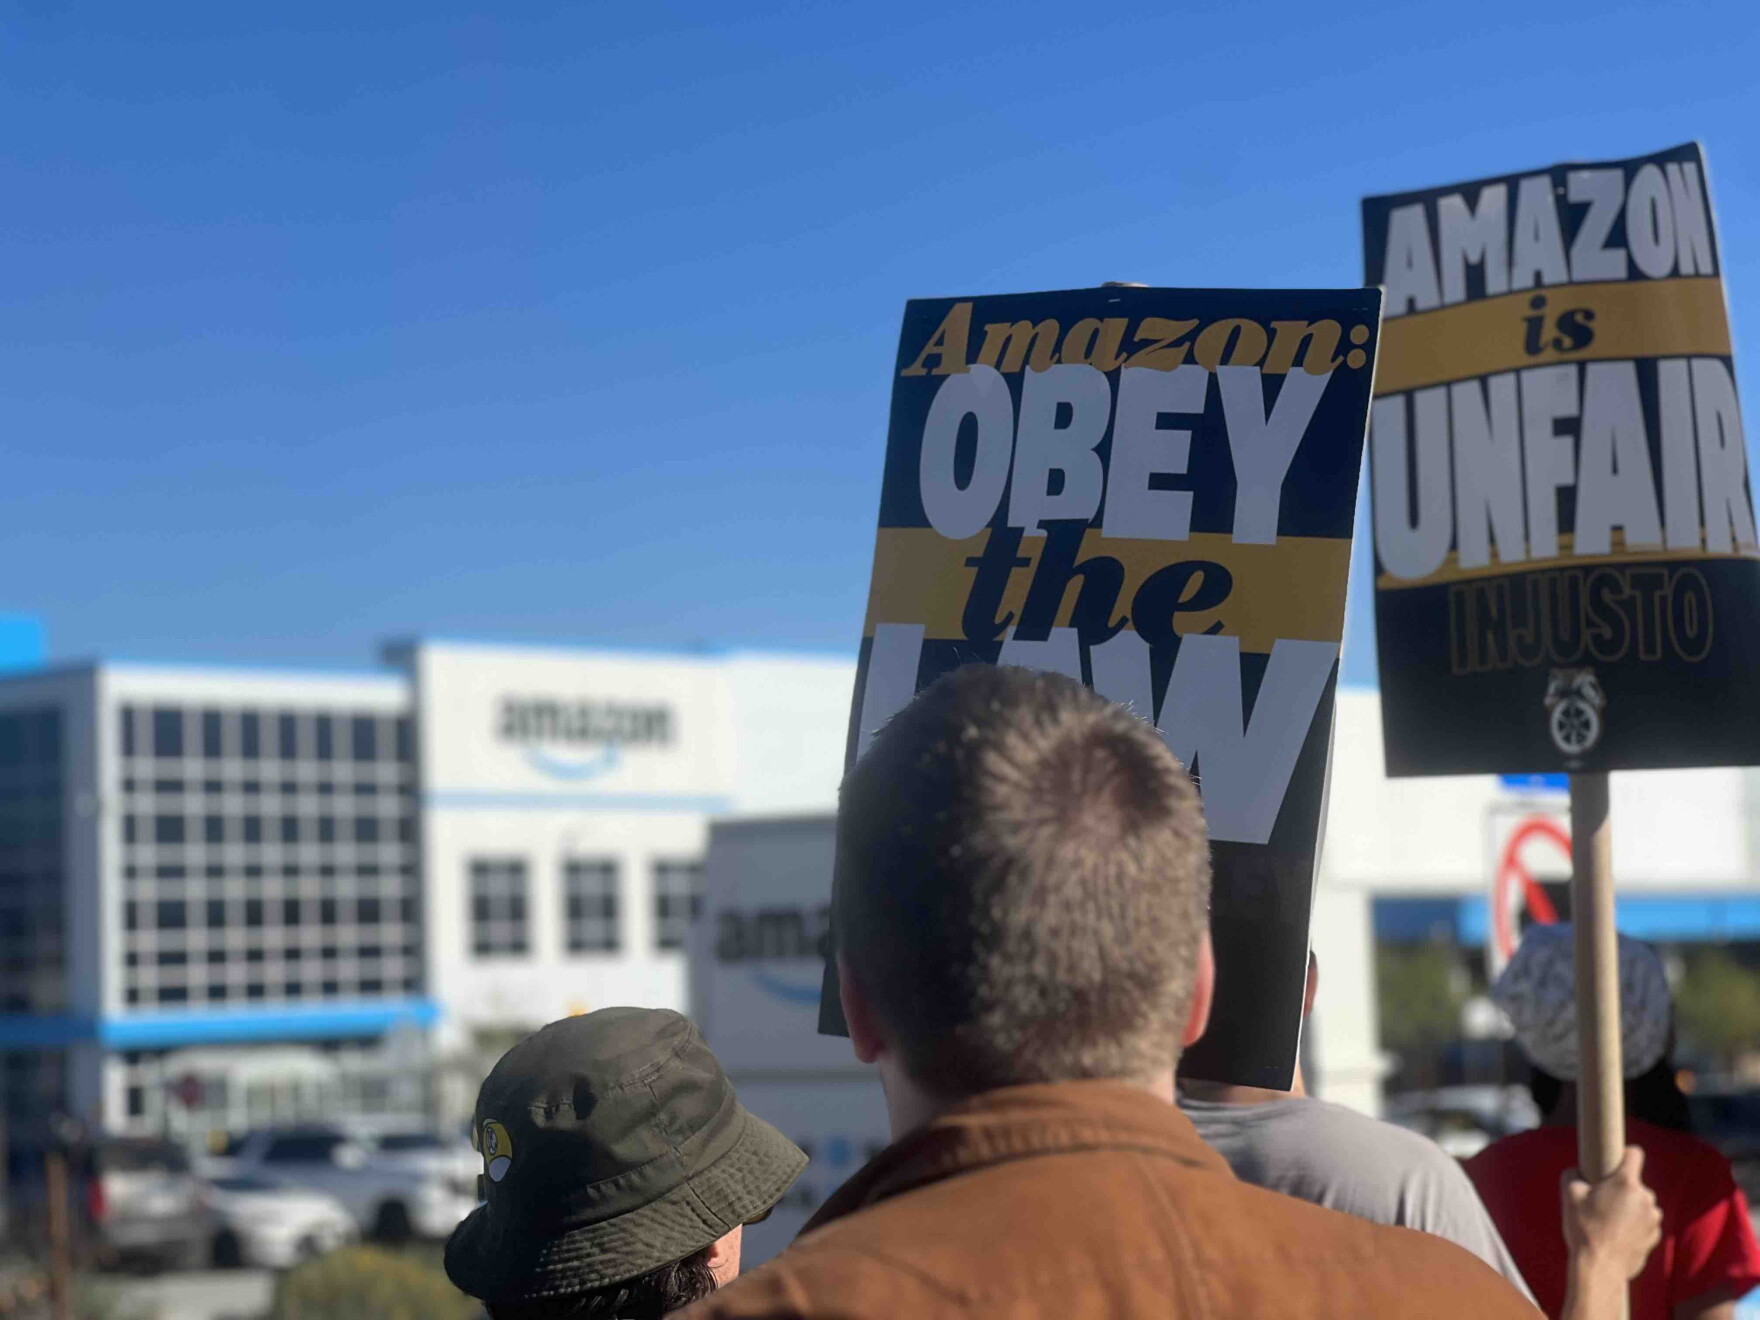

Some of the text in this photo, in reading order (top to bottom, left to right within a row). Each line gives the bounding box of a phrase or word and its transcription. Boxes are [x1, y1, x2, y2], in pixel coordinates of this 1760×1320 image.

[1382, 160, 1713, 315] AMAZON
[900, 301, 1370, 377] Amazon:
[1522, 296, 1597, 356] is
[919, 363, 1335, 545] OBEY
[1369, 358, 1760, 580] UNFAIR
[960, 518, 1233, 648] the
[1449, 567, 1714, 676] INJUSTO
